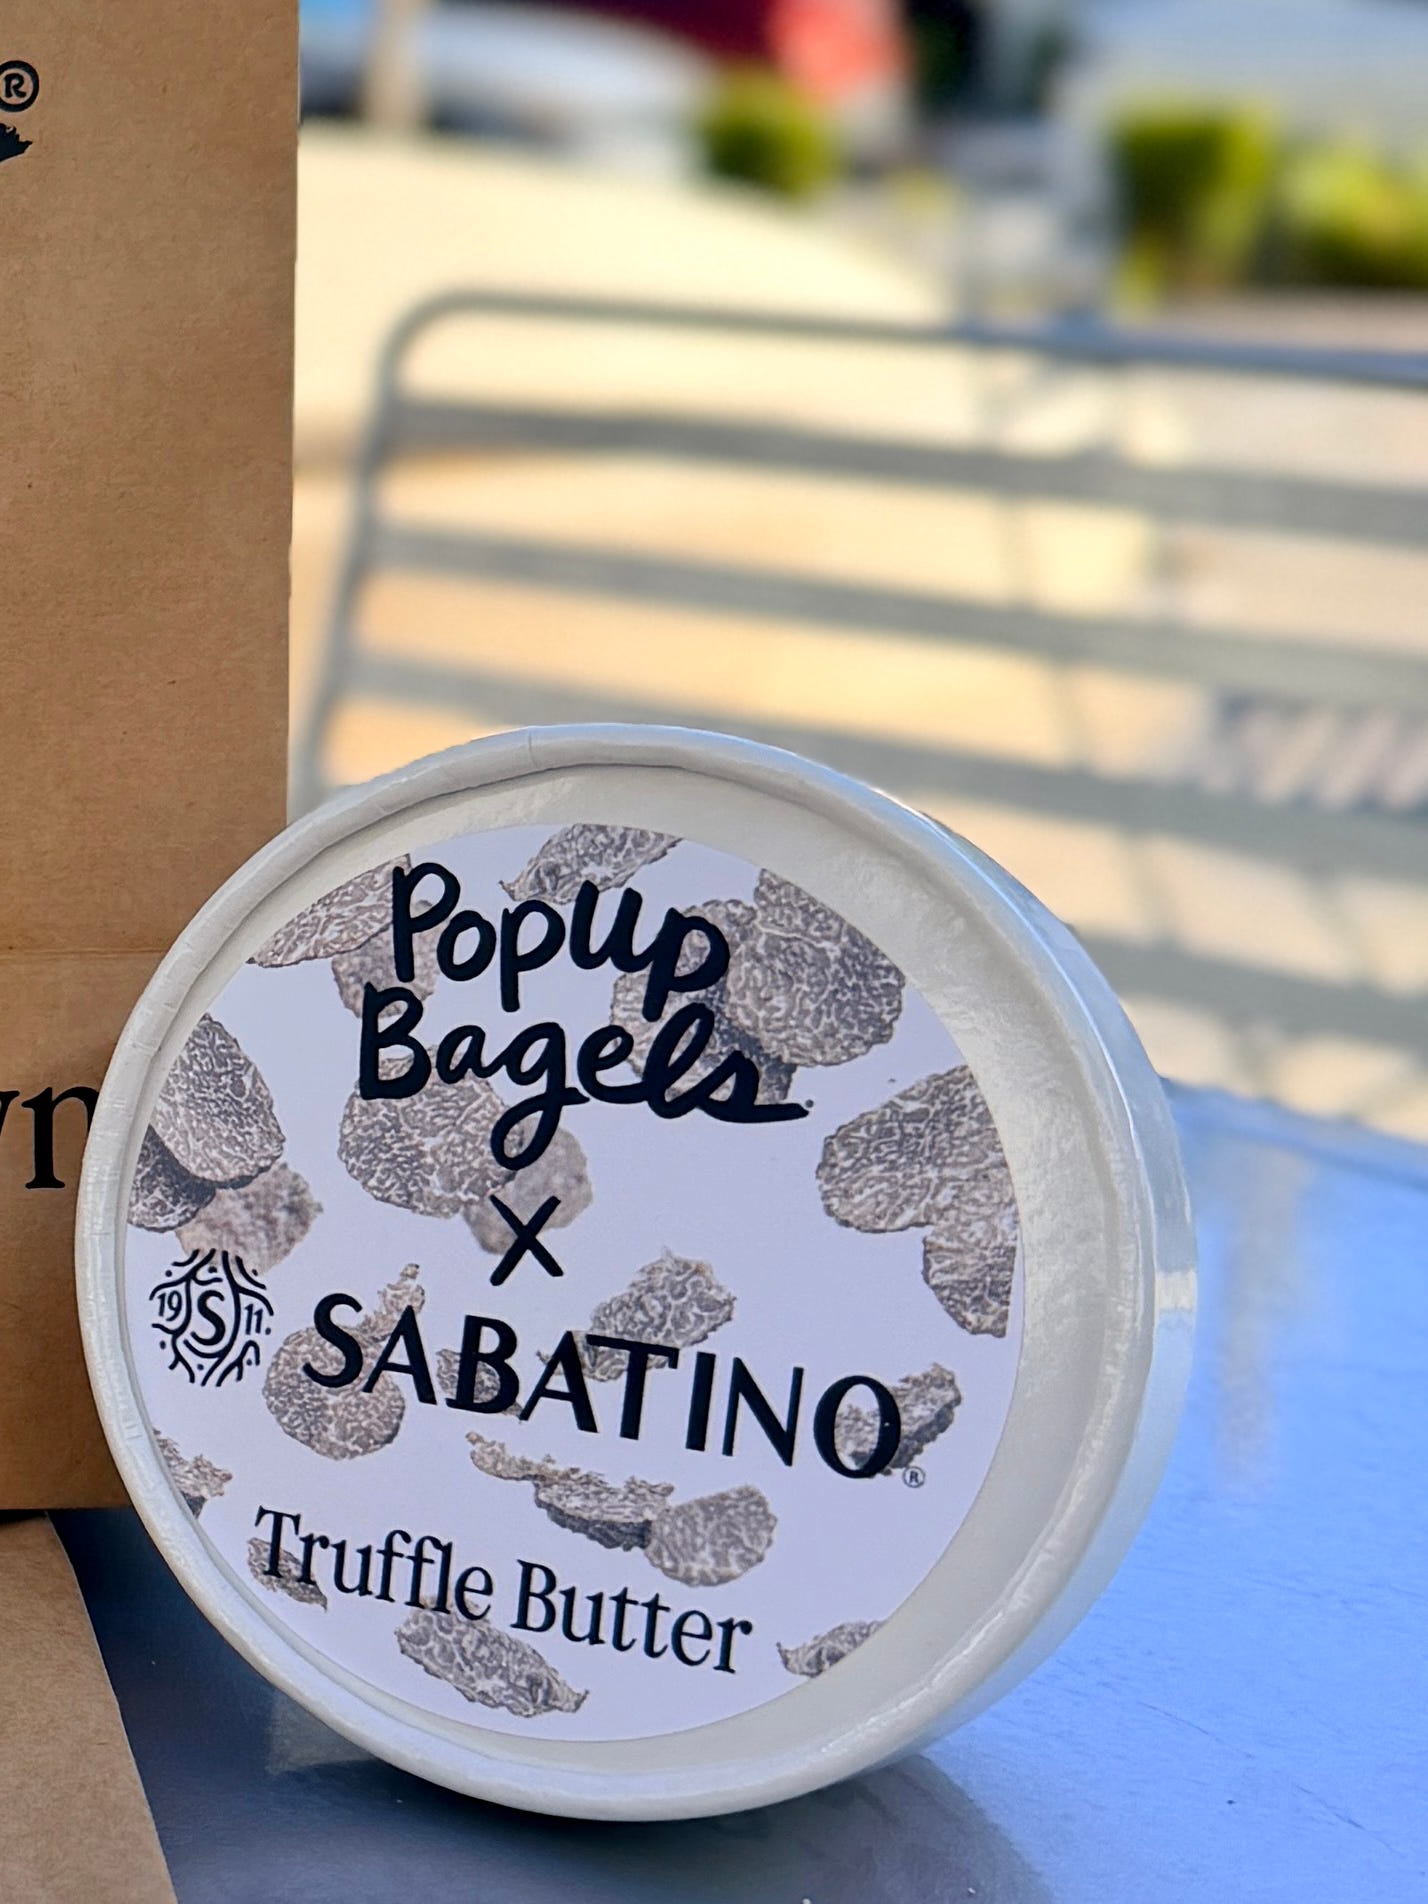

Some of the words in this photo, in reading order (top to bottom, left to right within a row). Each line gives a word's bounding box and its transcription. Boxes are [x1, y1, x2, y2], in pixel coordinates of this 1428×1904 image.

[358, 981, 810, 1172] Bagels
[157, 1290, 182, 1321] 19
[255, 1506, 493, 1621] Truffle
[511, 1559, 753, 1675] Butter
